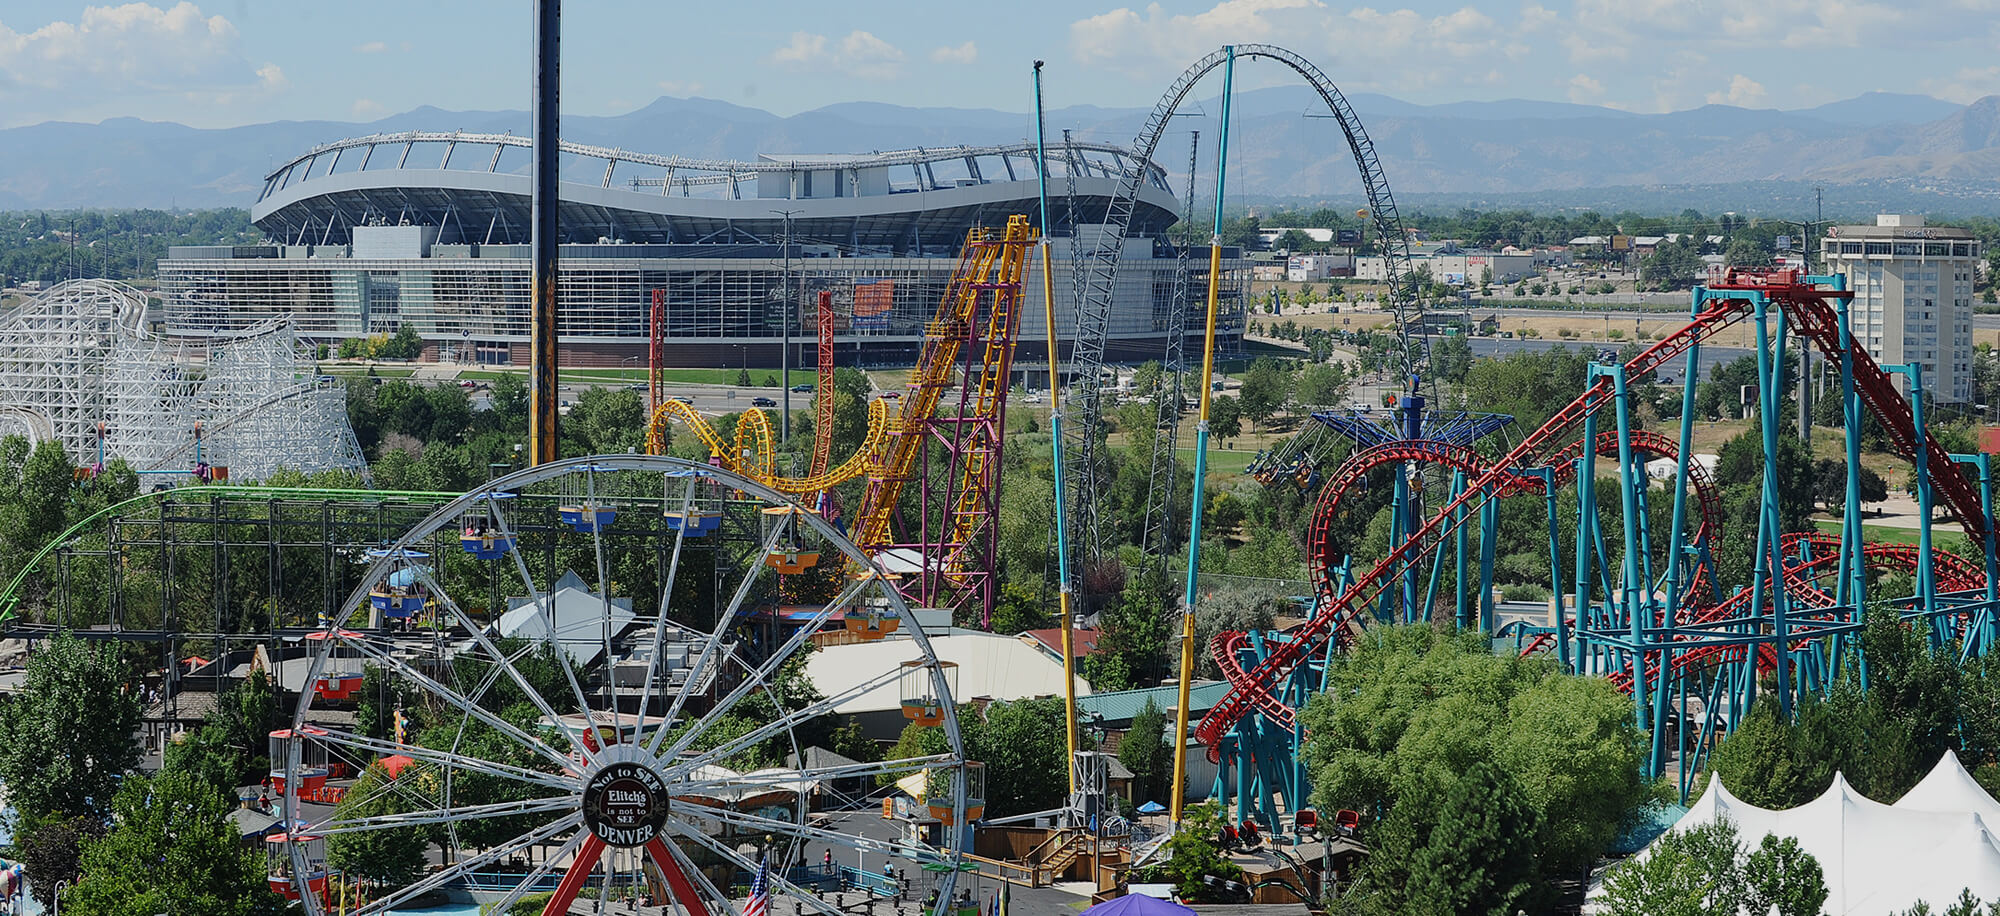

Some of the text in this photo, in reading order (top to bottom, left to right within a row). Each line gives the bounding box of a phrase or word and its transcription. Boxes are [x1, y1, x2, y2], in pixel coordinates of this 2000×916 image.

[591, 767, 663, 793] Not to SEE
[607, 790, 647, 804] Elitch's
[598, 822, 653, 844] DENVER
